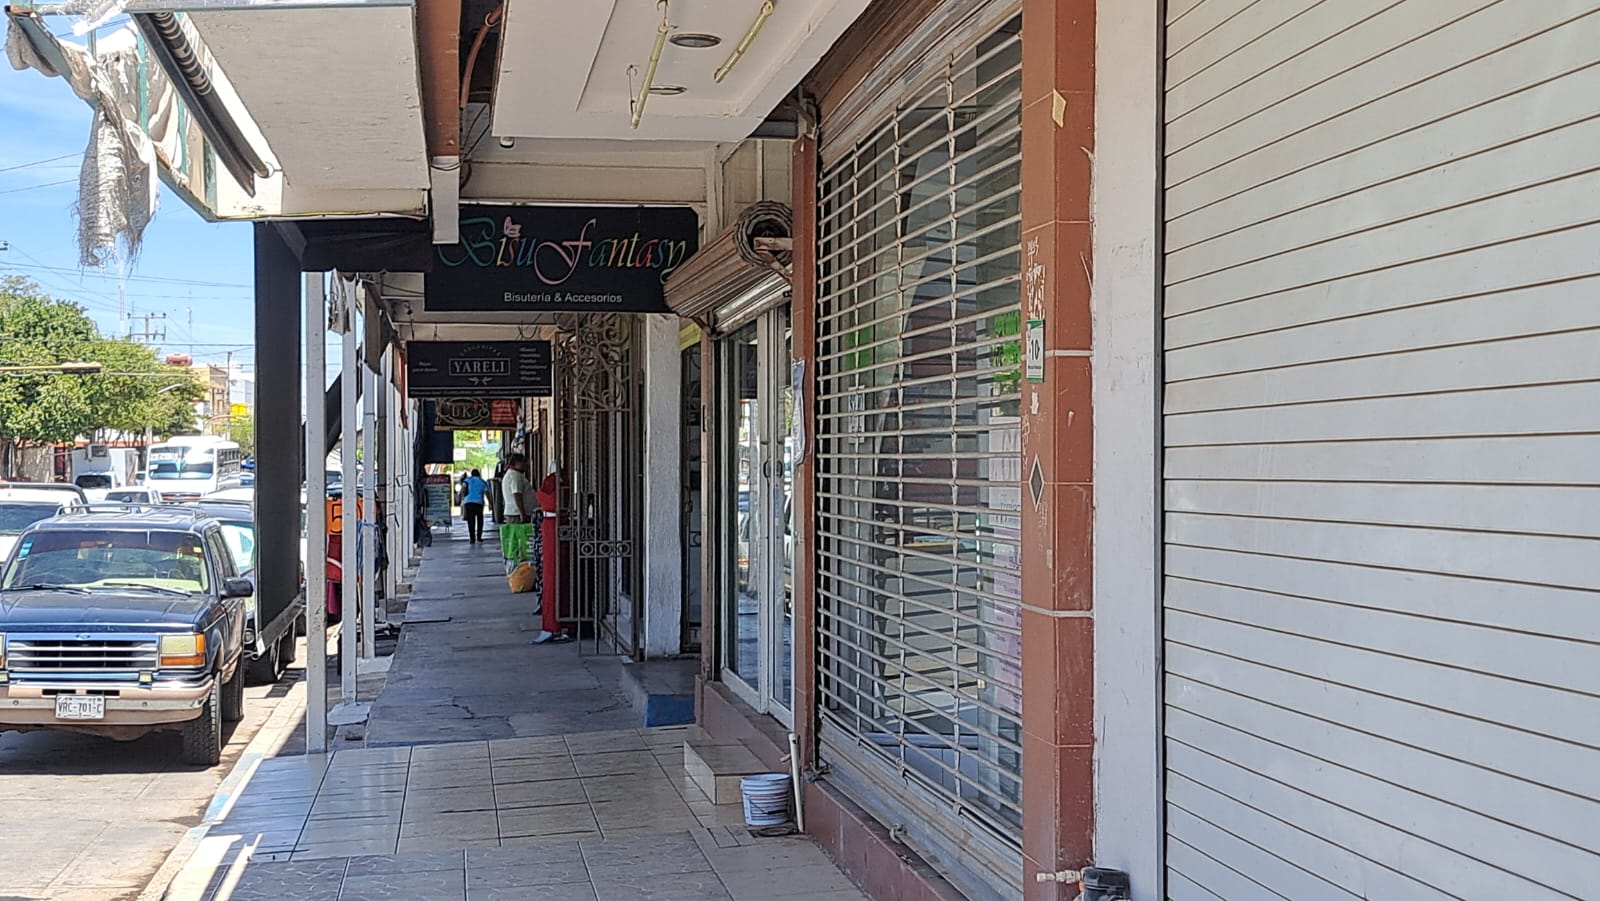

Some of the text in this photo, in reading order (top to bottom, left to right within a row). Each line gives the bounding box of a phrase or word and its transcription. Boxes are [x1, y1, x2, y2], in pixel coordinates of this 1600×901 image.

[554, 292, 562, 302] &
[564, 292, 622, 303] Accesorios
[454, 361, 504, 373] YARELI
